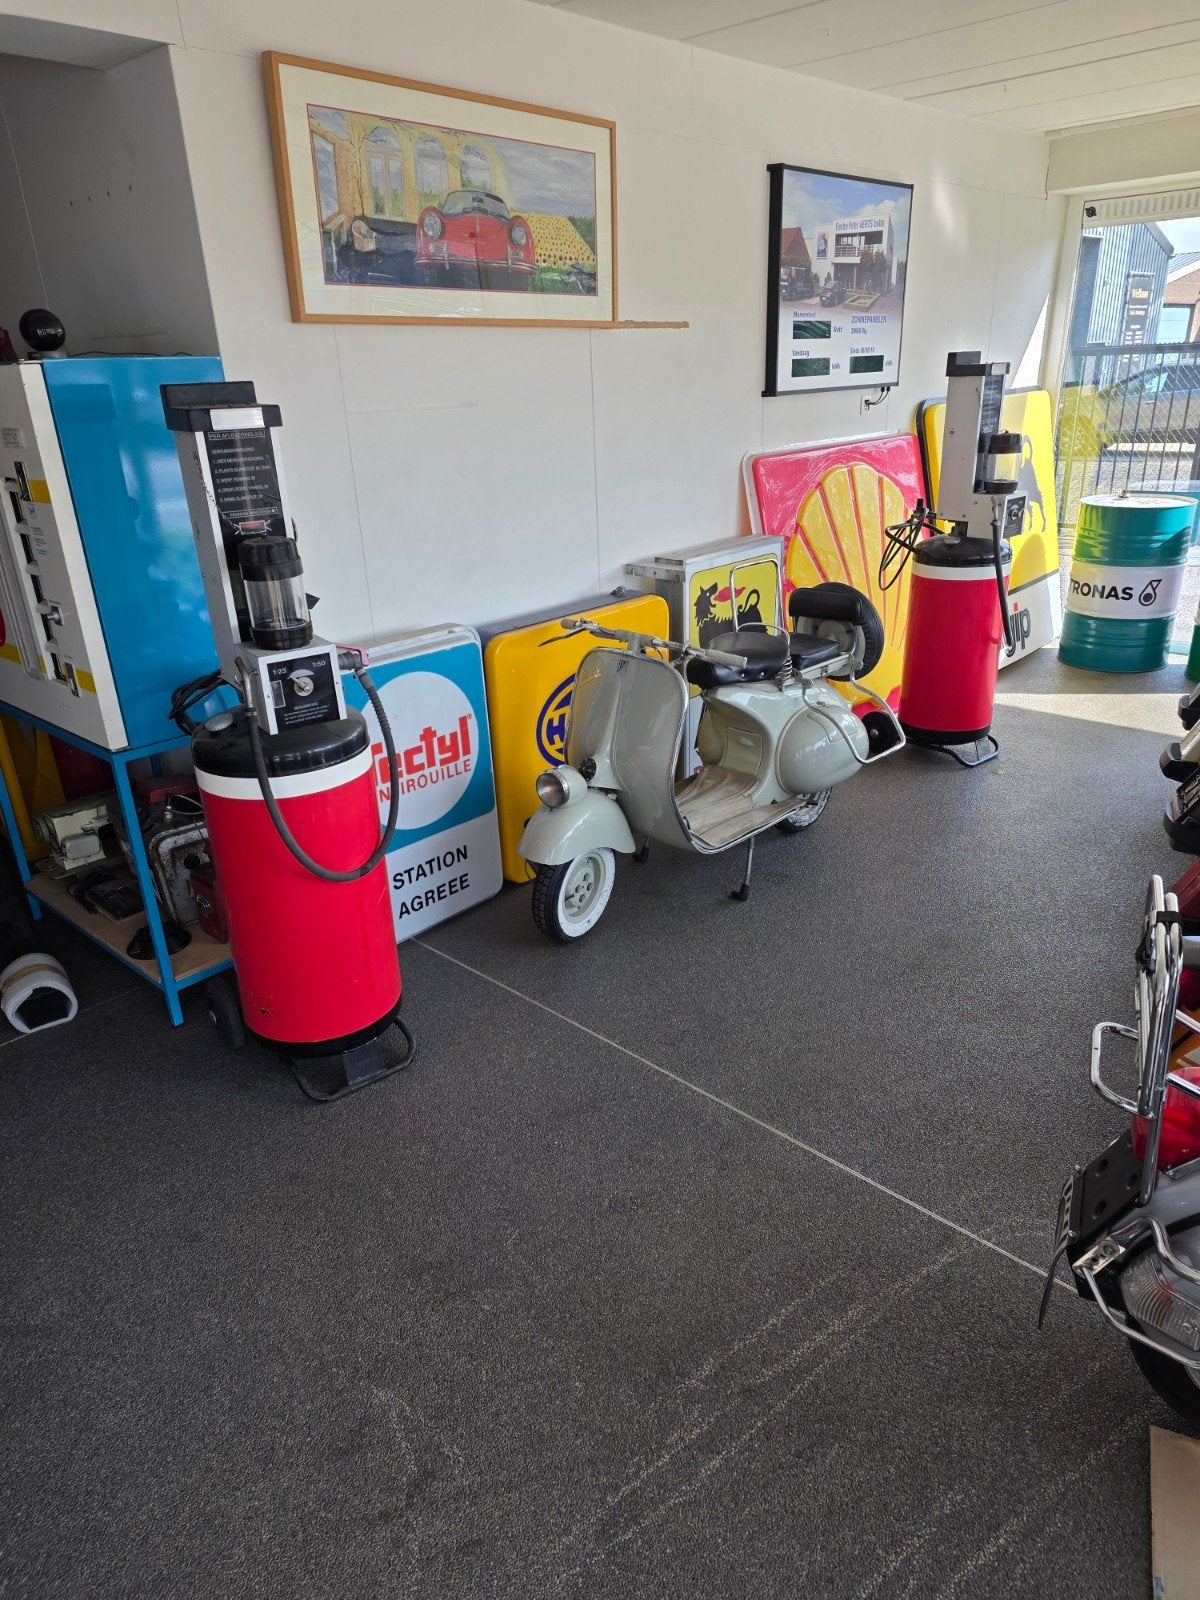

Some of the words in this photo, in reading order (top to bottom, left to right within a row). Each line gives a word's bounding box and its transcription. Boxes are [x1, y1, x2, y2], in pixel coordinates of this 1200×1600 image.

[859, 219, 873, 228] AERTS
[851, 315, 887, 323] ZONNEPANELEN
[792, 349, 810, 357] Vandaag
[1070, 578, 1133, 601] TRONAS
[1002, 602, 1031, 657] gip
[379, 758, 472, 803] NIROUILLE
[392, 845, 468, 890] STATION
[398, 872, 470, 919] AGREEE
